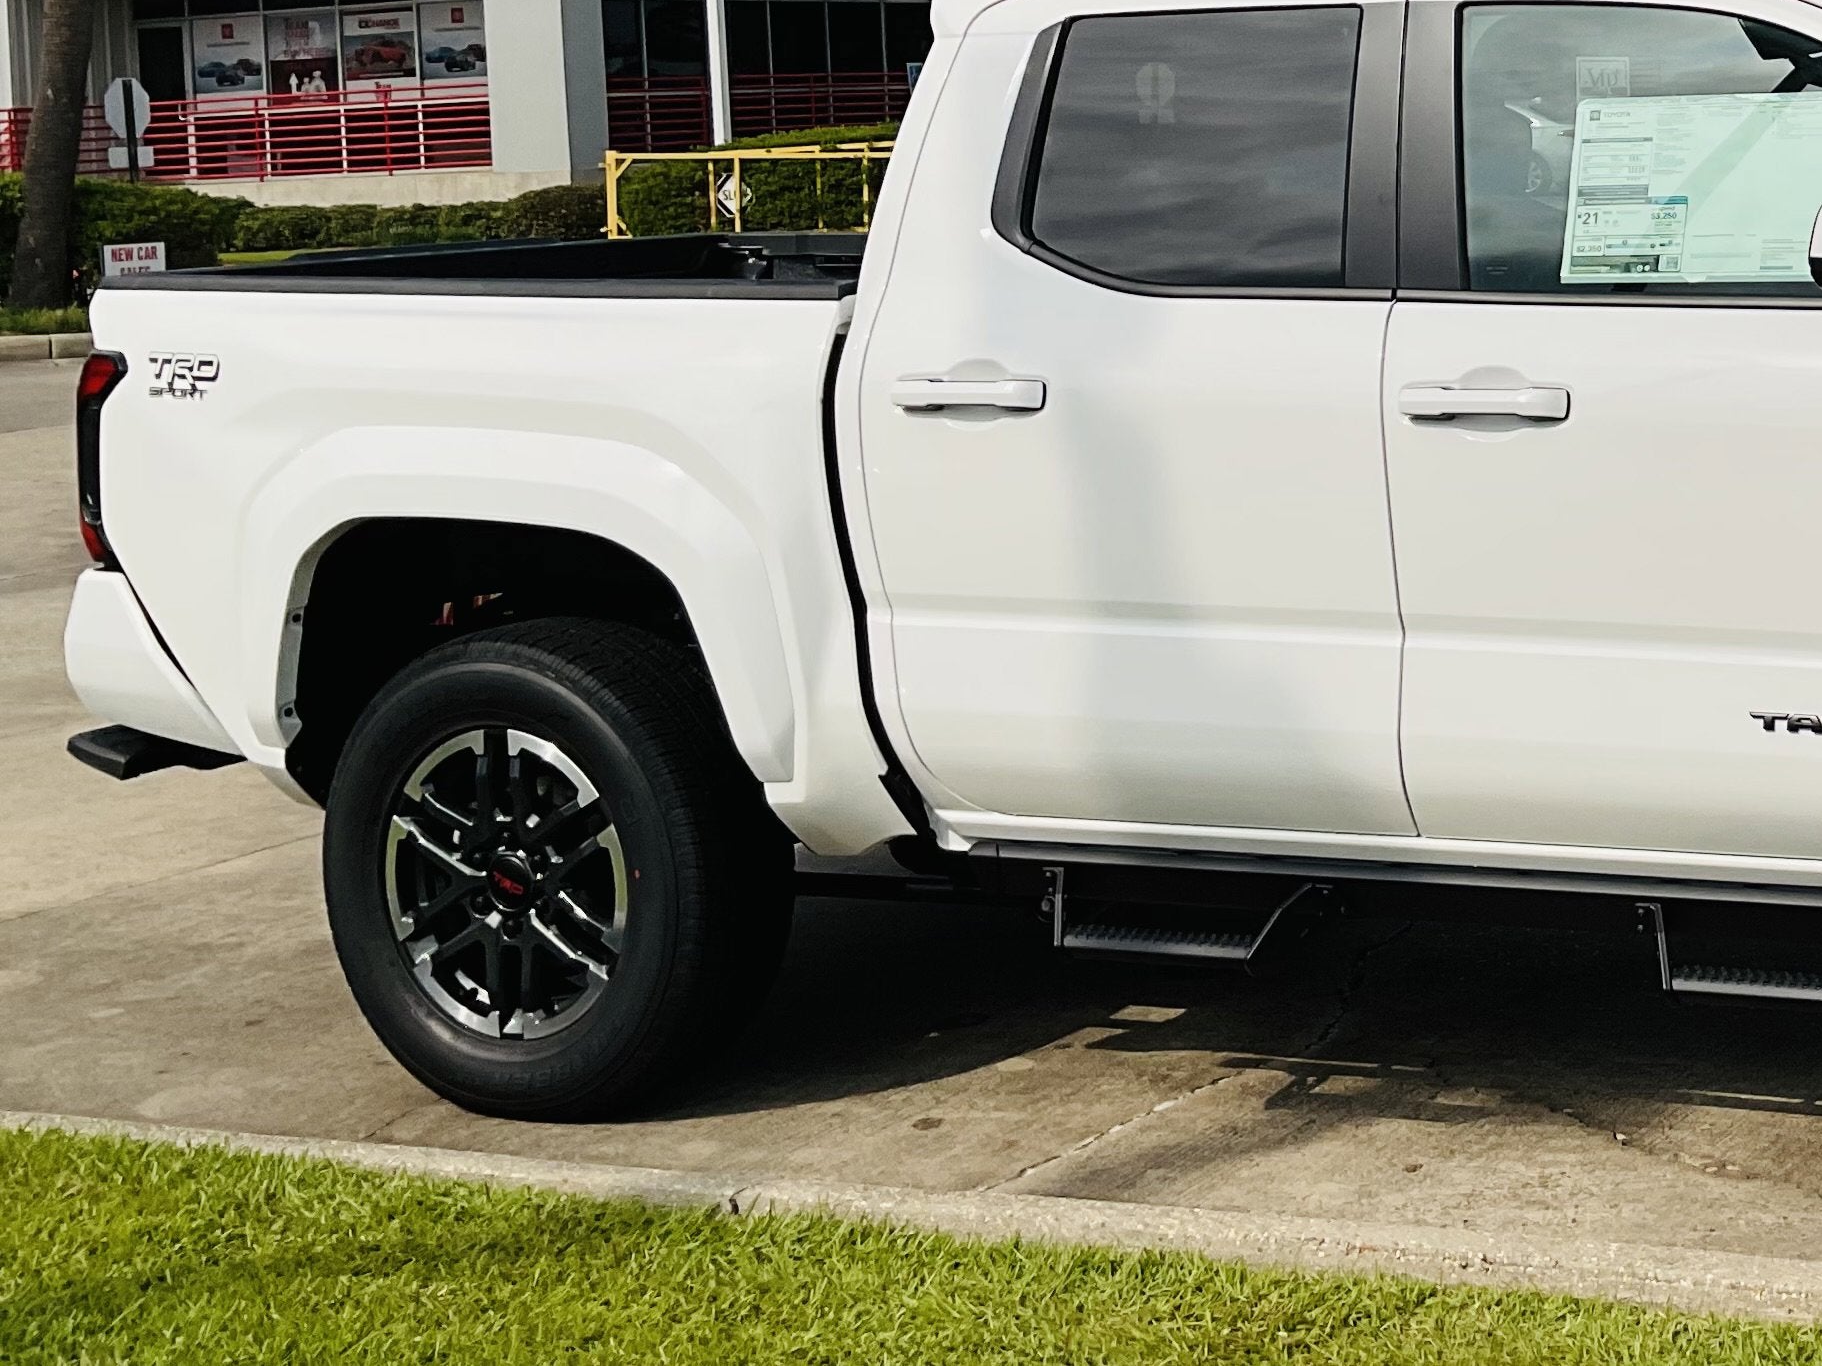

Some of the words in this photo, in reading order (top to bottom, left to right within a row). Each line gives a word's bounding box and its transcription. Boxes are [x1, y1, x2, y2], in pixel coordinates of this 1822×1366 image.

[1582, 212, 1599, 225] 21
[111, 248, 133, 263] NEW
[137, 246, 158, 260] CAR
[148, 352, 221, 391] TRD
[149, 386, 208, 400] SPORT
